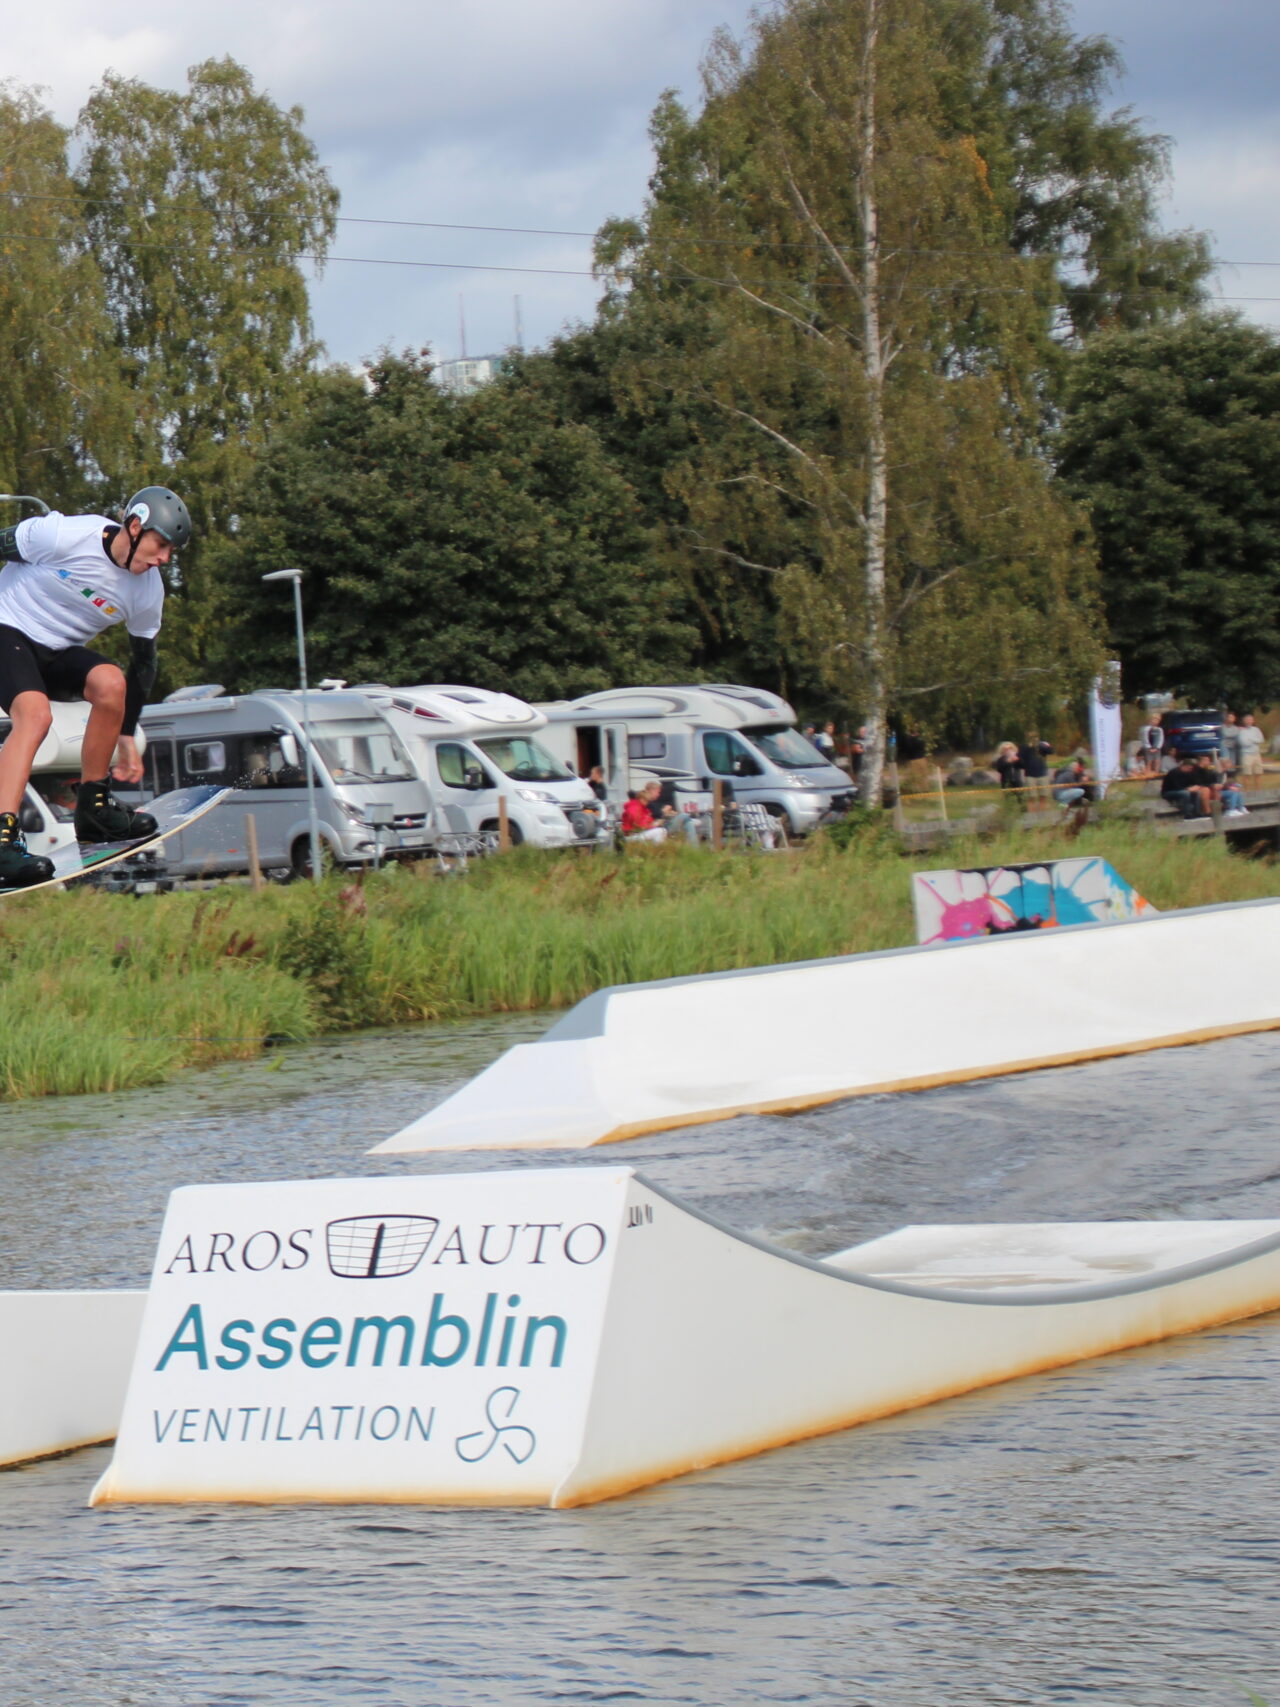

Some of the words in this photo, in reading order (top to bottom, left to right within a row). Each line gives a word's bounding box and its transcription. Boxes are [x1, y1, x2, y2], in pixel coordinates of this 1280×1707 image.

[163, 1228, 313, 1274] AROS
[431, 1221, 607, 1266] AUTO
[154, 1292, 568, 1371] Assemblin
[153, 1405, 436, 1443] VENTILATION
